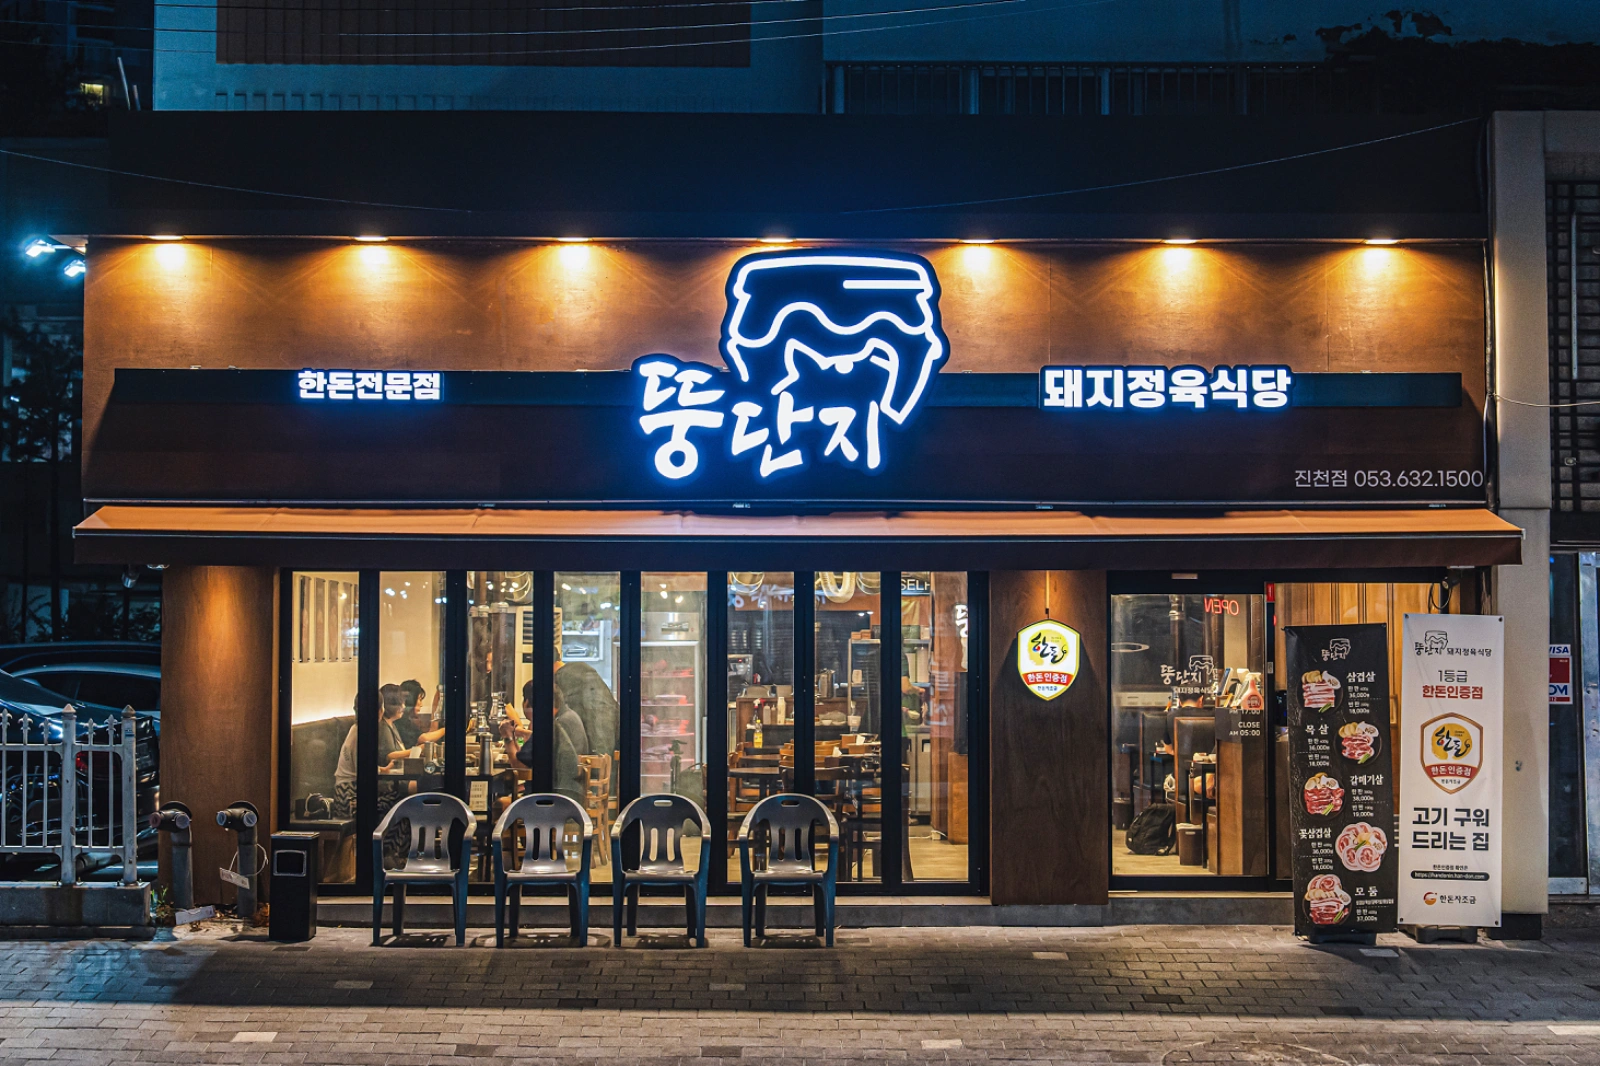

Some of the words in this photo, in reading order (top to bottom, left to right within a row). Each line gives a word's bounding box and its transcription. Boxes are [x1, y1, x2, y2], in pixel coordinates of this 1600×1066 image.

[298, 370, 441, 401] 한돈전문점
[1043, 368, 1292, 409] 돼지정육식당
[638, 360, 882, 480] 뚱단지
[1294, 469, 1348, 488] 진천점
[1353, 469, 1484, 488] 053.632.1500
[1446, 647, 1493, 658] 돼지정육식당
[1160, 664, 1202, 685] 뚱단지
[1346, 671, 1376, 683] 삼겹살
[1437, 669, 1469, 684] 1등급
[1422, 684, 1484, 700] 한돈인증점
[1238, 721, 1261, 729] CLOSE
[1240, 729, 1261, 737] 05:00
[1430, 765, 1472, 777] 한돈인증점
[1350, 774, 1384, 787] 갈매기살
[1412, 807, 1448, 826] 고기
[1454, 808, 1490, 828] 구워
[1298, 827, 1332, 840] 꽃삼겹살
[1411, 831, 1467, 851] 드리는
[1472, 832, 1490, 851] 집
